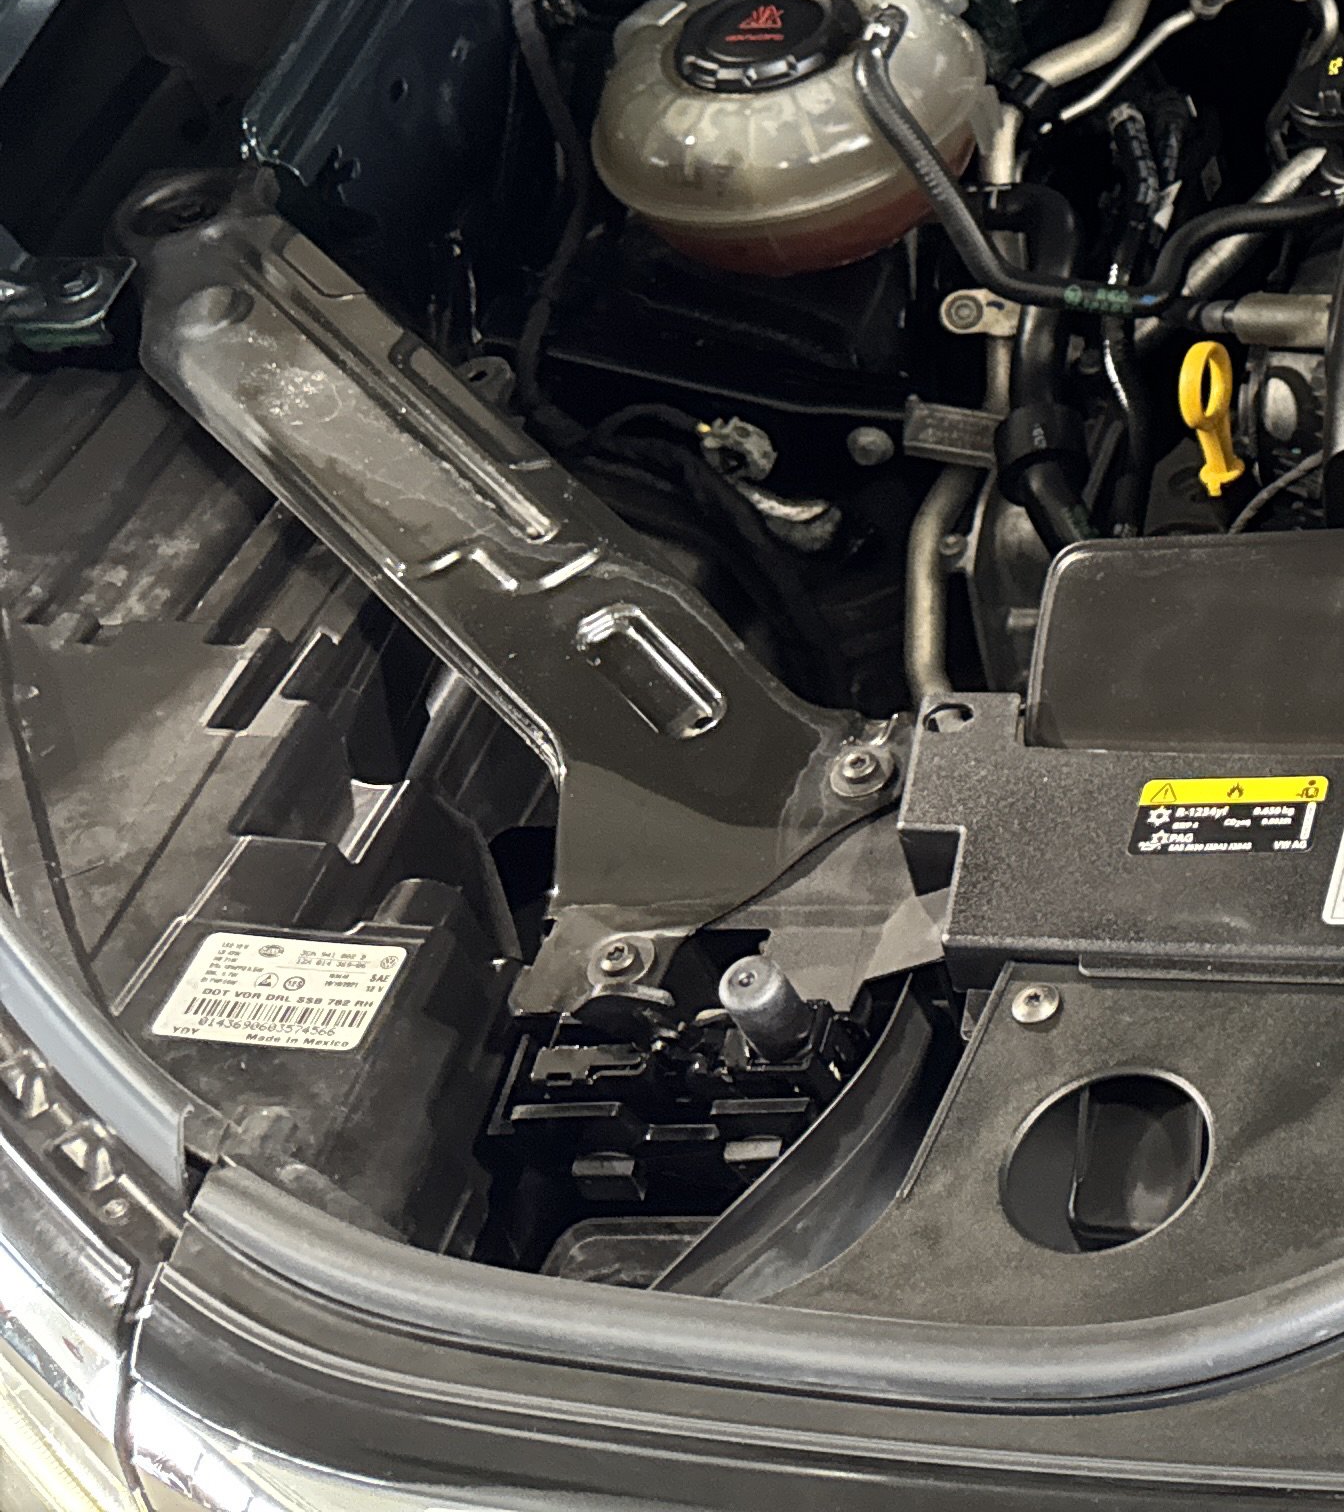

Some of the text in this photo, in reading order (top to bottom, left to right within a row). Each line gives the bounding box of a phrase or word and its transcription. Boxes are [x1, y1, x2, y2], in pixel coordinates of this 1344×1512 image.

[370, 974, 390, 982] SAE
[201, 988, 230, 997] DOT
[246, 1033, 281, 1042] Made
[286, 1036, 298, 1044] in
[303, 1038, 349, 1048] Mexico
